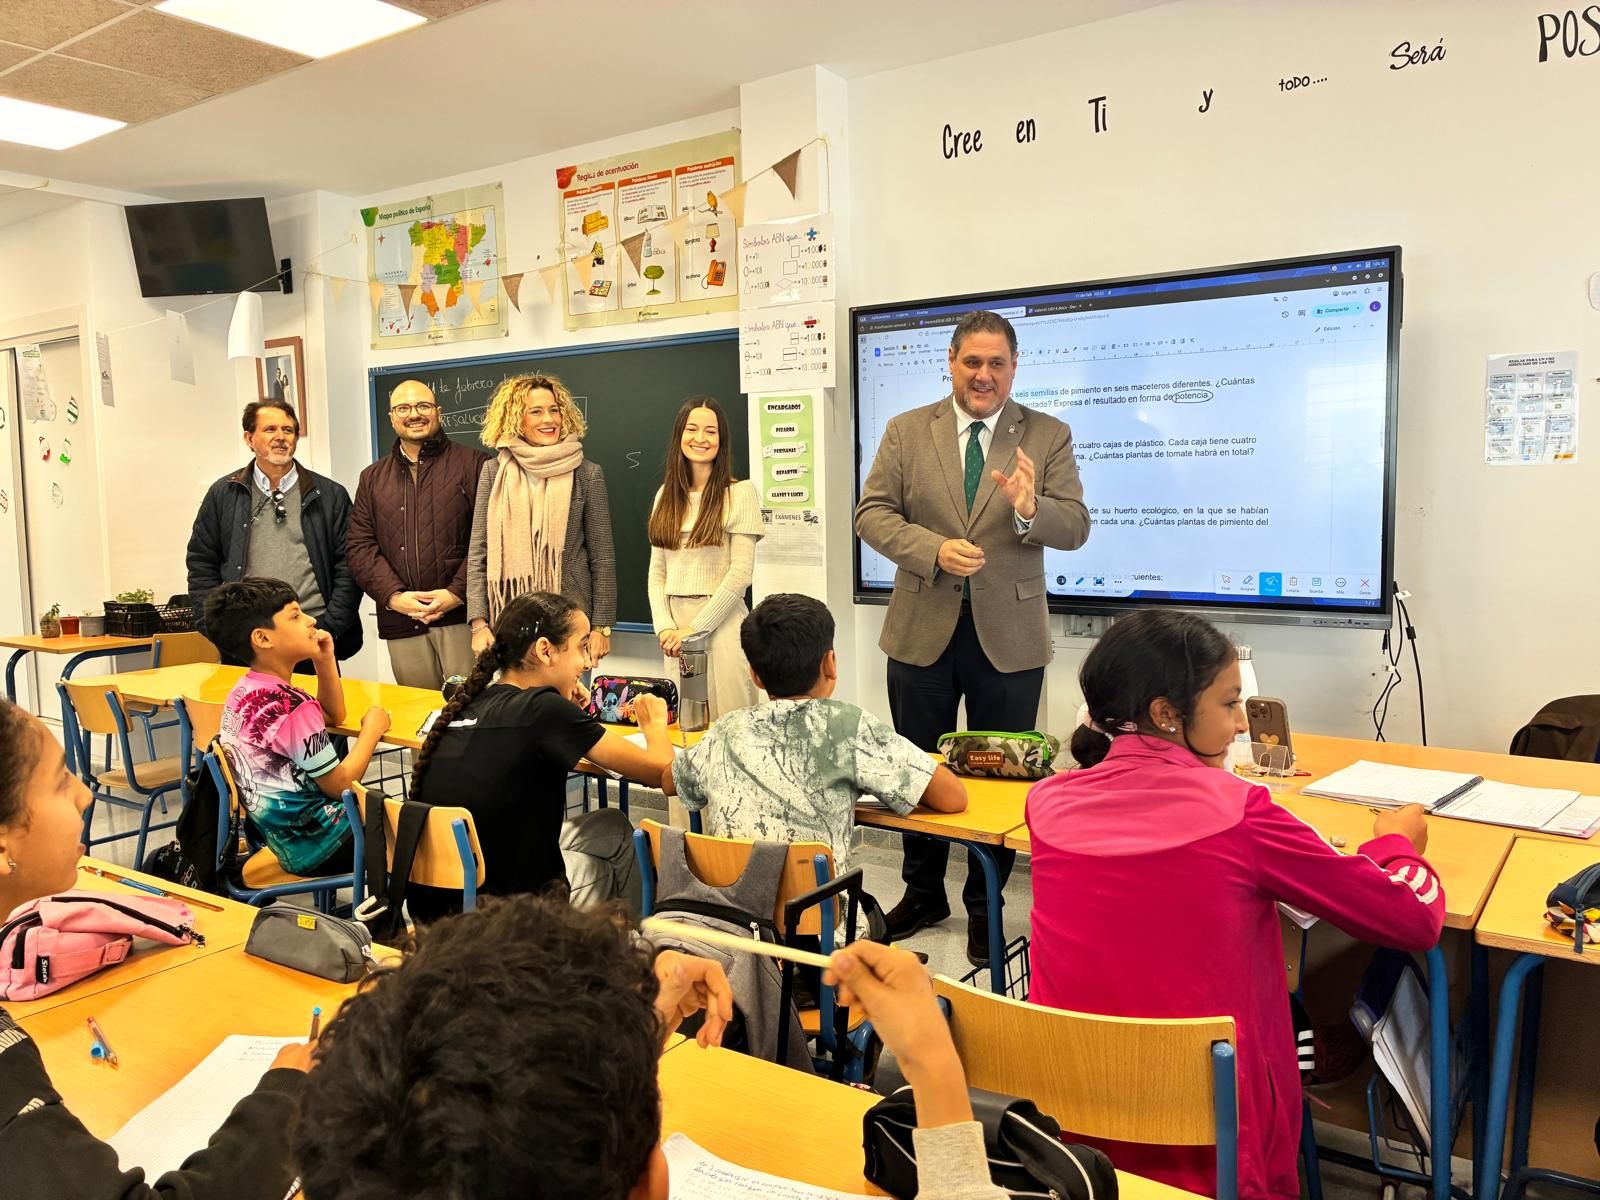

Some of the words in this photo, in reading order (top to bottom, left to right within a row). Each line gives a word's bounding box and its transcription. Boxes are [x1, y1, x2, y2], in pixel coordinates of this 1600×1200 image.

[942, 124, 983, 160] Cree
[1015, 114, 1037, 145] en
[1088, 96, 1108, 134] Ti
[1198, 88, 1214, 114] y
[1388, 38, 1447, 71] Será
[1537, 5, 1600, 63] POS
[576, 172, 596, 183] Reglas
[596, 169, 604, 178] de
[605, 162, 639, 176] acentuación
[379, 212, 392, 221] Mapa
[392, 209, 409, 218] político
[415, 205, 431, 215] España
[772, 232, 785, 243] ABN
[1325, 306, 1350, 314] Compartir
[1015, 390, 1029, 398] seis
[1030, 387, 1059, 398] semillas
[1059, 386, 1069, 396] de
[1071, 385, 1102, 398] pimiento
[1102, 385, 1113, 394] en
[1114, 383, 1130, 393] seis
[1130, 380, 1171, 392] maceteros
[1172, 379, 1213, 390] diferentes.
[1215, 376, 1256, 388] ¿Cuántas
[1053, 397, 1083, 409] Expresa
[1084, 397, 1091, 405] el
[1092, 395, 1127, 405] resultado
[1128, 394, 1138, 403] en
[1139, 392, 1162, 403] forma
[1163, 392, 1173, 401] de
[440, 413, 487, 428] RESOLUCI
[1078, 440, 1101, 449] cuatro
[1102, 439, 1122, 451] cajas
[1124, 439, 1134, 448] de
[1135, 437, 1166, 450] plástico.
[1168, 437, 1189, 446] Cada
[1191, 436, 1208, 447] caja
[1209, 436, 1229, 445] tiene
[1230, 435, 1257, 445] cuatro
[1088, 450, 1125, 460] ¿Cuántas
[1125, 449, 1153, 461] plantas
[1154, 448, 1165, 457] de
[1166, 448, 1193, 457] tomate
[1194, 447, 1218, 457] habrá
[1219, 448, 1230, 456] en
[1231, 447, 1255, 456] total?
[1141, 506, 1180, 516] ecológico,
[1207, 508, 1223, 516] que
[1100, 517, 1118, 525] cada
[1138, 517, 1175, 527] ¿Cuántas
[1177, 517, 1206, 527] plantas
[1207, 517, 1218, 525] de
[1219, 517, 1254, 527] pimiento
[1255, 517, 1269, 525] del
[1132, 573, 1164, 582] uientes:
